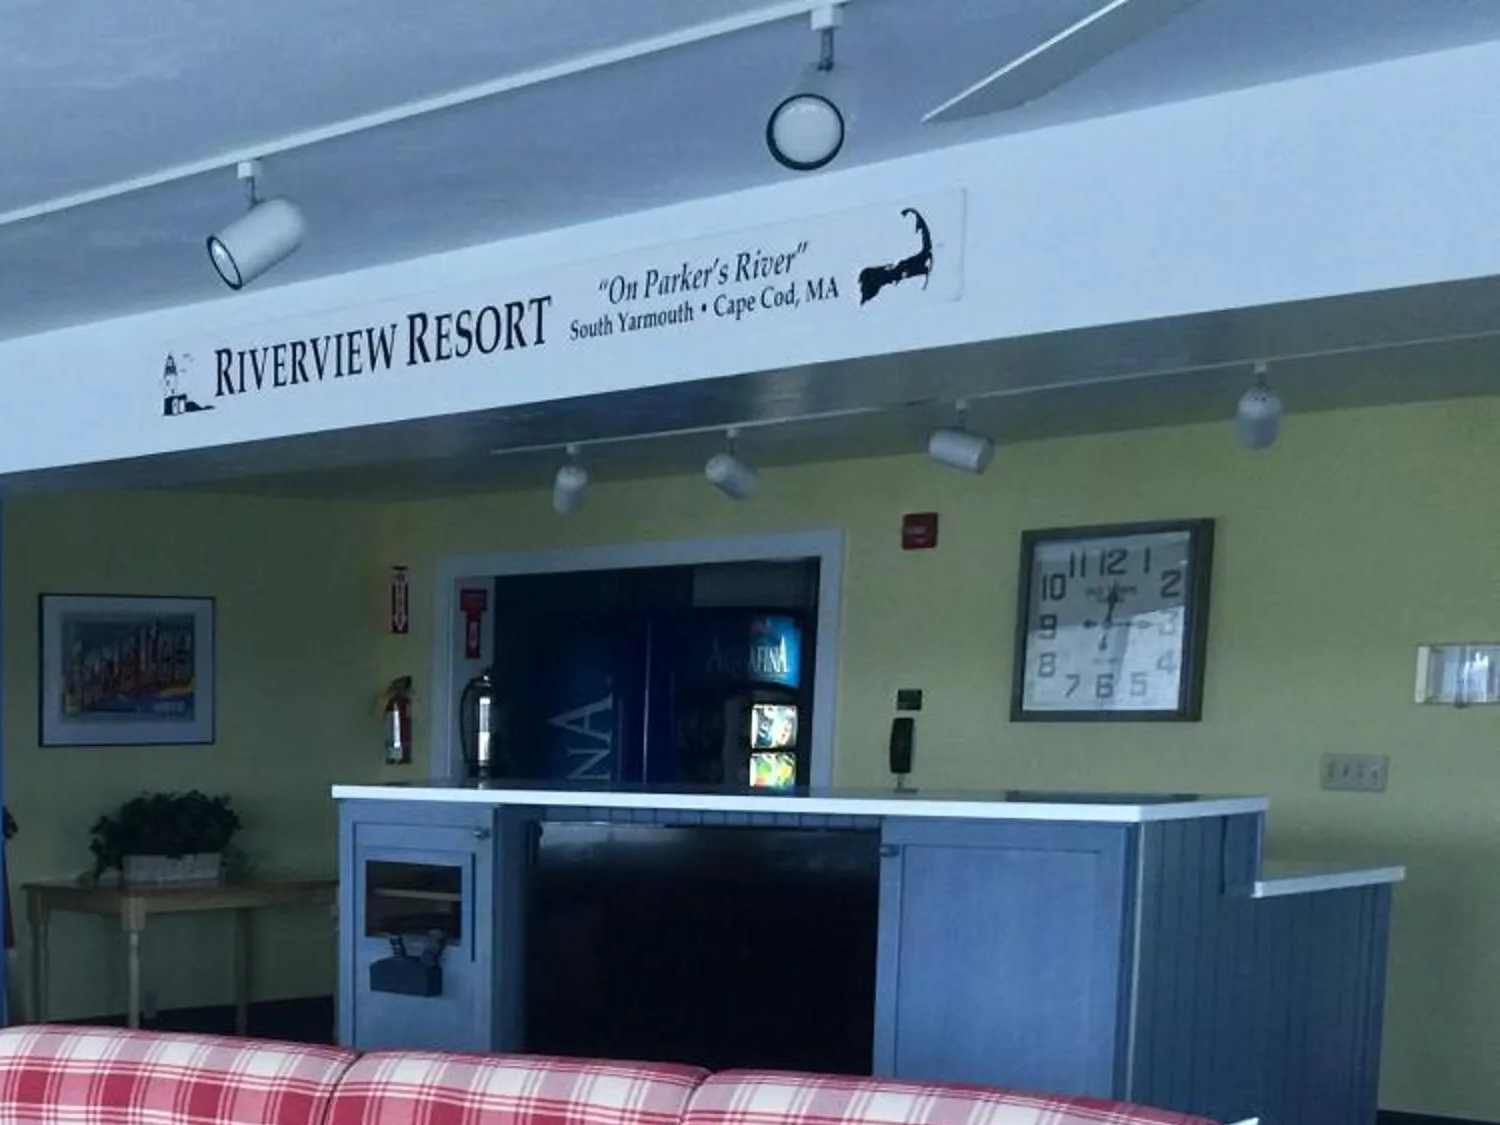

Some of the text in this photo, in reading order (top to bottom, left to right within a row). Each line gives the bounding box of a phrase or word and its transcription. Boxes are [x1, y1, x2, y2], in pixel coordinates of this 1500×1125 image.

[569, 275, 840, 341] South Yarmouth Cape Cod, MA
[214, 295, 552, 397] RIVERVIEW RESORT
[1069, 552, 1086, 578] 11
[1100, 548, 1128, 577] 12
[1142, 547, 1151, 574] 1
[1041, 573, 1066, 601] 10
[1160, 569, 1182, 599] 2
[1038, 614, 1058, 640] 9
[1158, 609, 1179, 636] 3
[1037, 652, 1057, 678] 8
[1155, 649, 1177, 675] 4
[1064, 674, 1081, 698] 7
[1095, 674, 1115, 699] 6
[1129, 672, 1150, 697] 5
